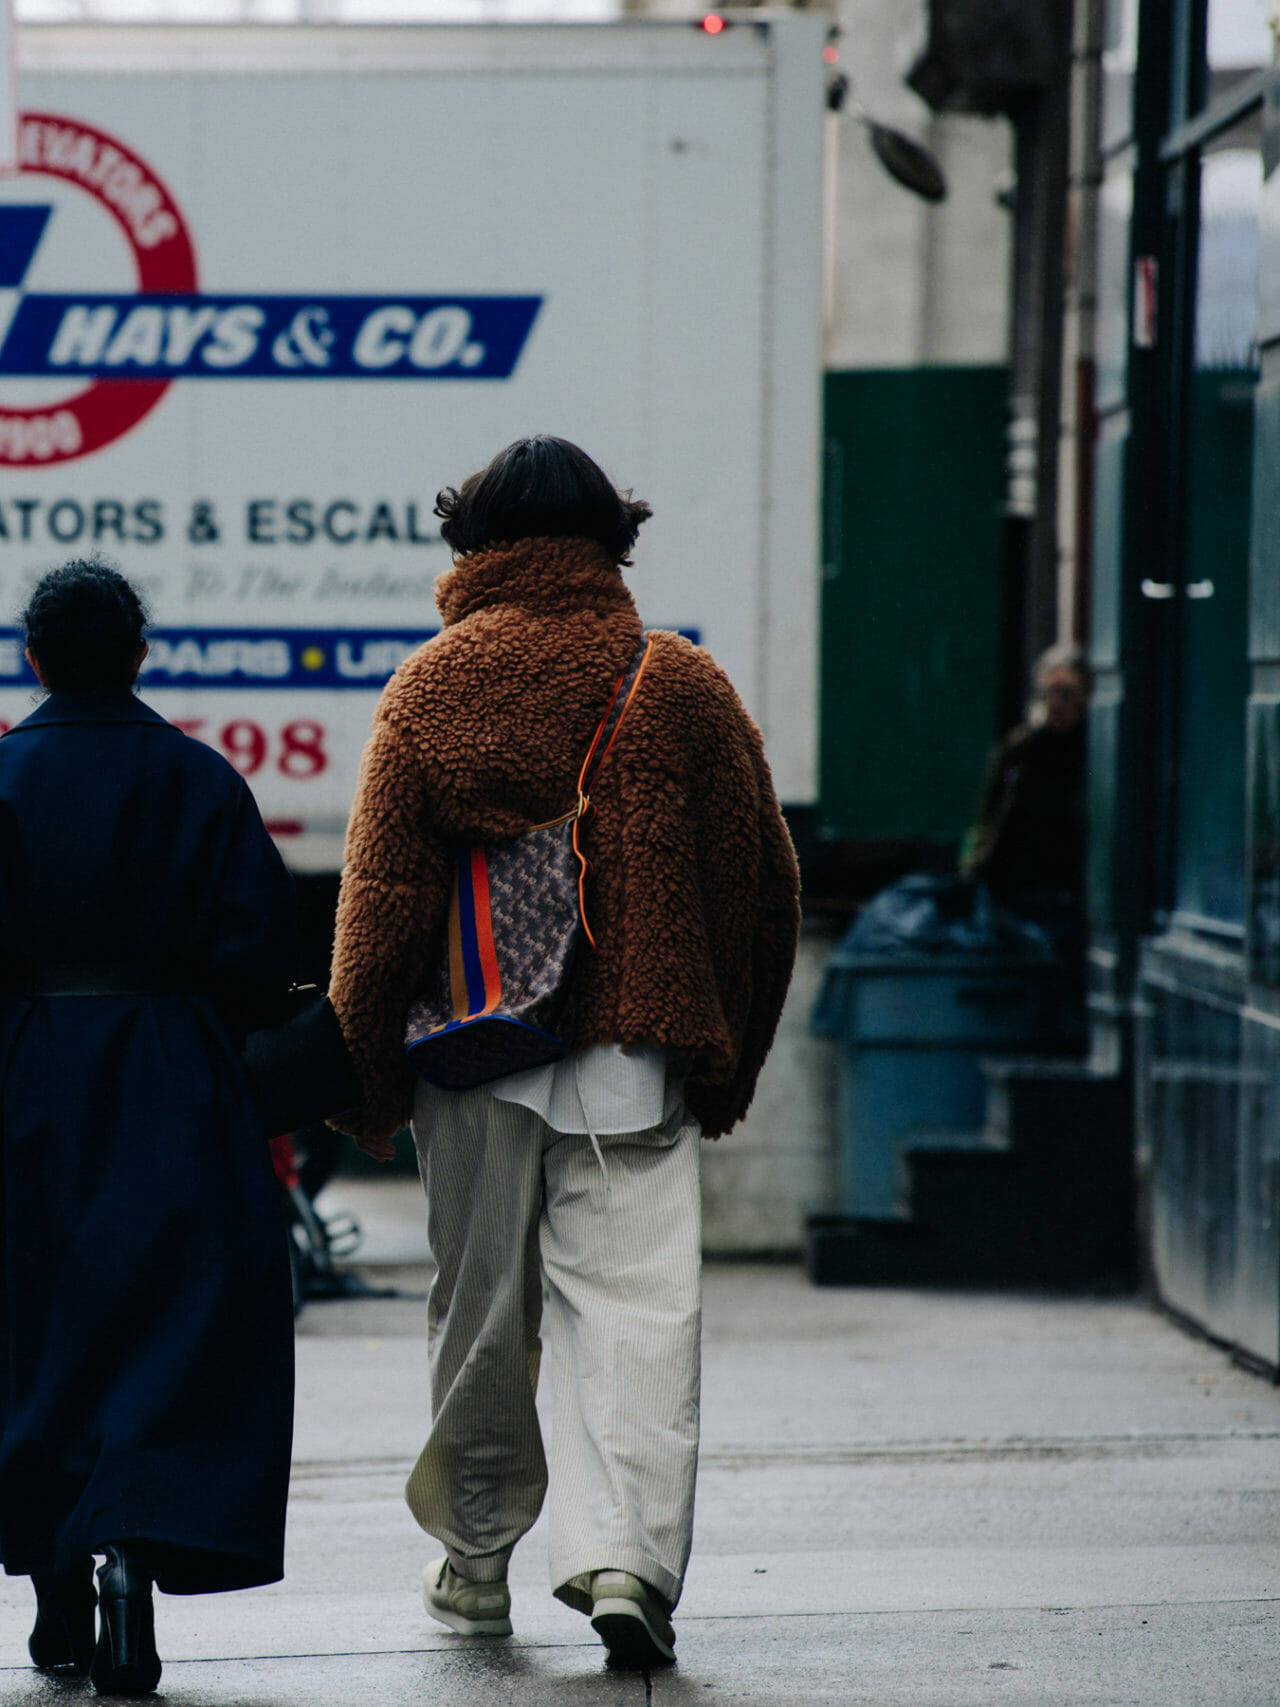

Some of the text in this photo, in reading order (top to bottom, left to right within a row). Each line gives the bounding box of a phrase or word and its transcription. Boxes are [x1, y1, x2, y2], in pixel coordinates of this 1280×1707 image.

[47, 304, 488, 369] HAYS & CO.
[186, 499, 222, 545] &
[246, 499, 442, 545] ESCAL
